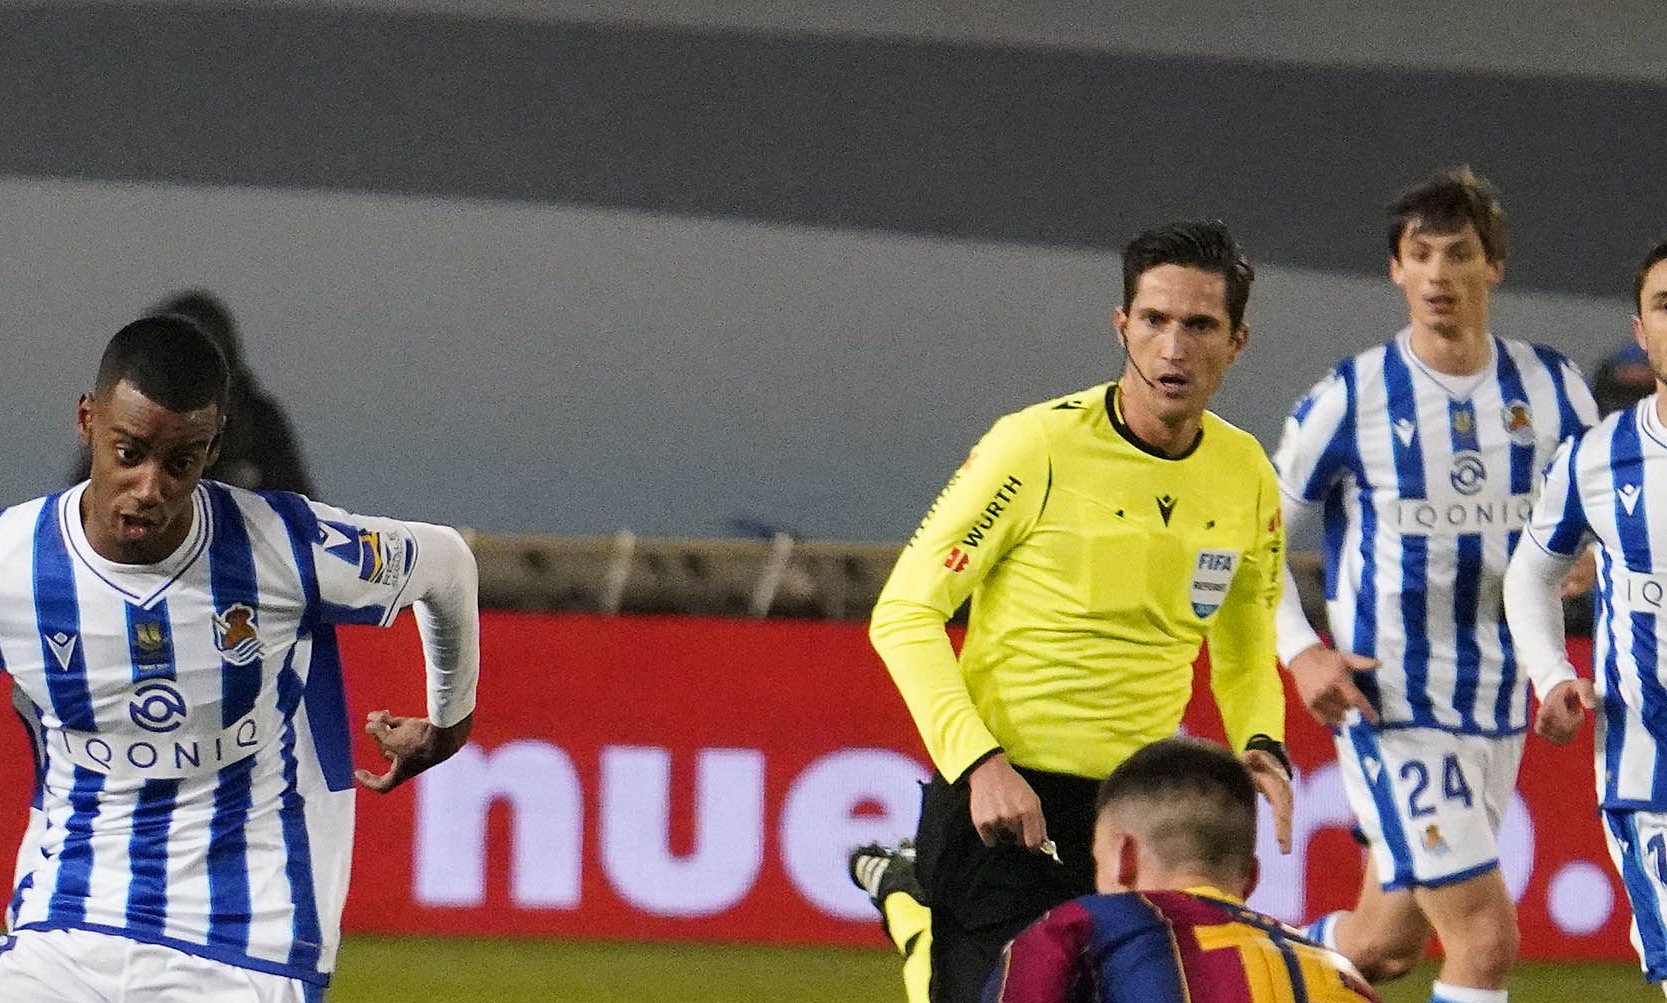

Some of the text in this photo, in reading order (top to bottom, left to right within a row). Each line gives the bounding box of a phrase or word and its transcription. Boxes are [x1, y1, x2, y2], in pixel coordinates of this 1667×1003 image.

[1198, 553, 1232, 571] FIFA
[60, 717, 259, 770] IQONIQ
[1399, 752, 1474, 819] 24
